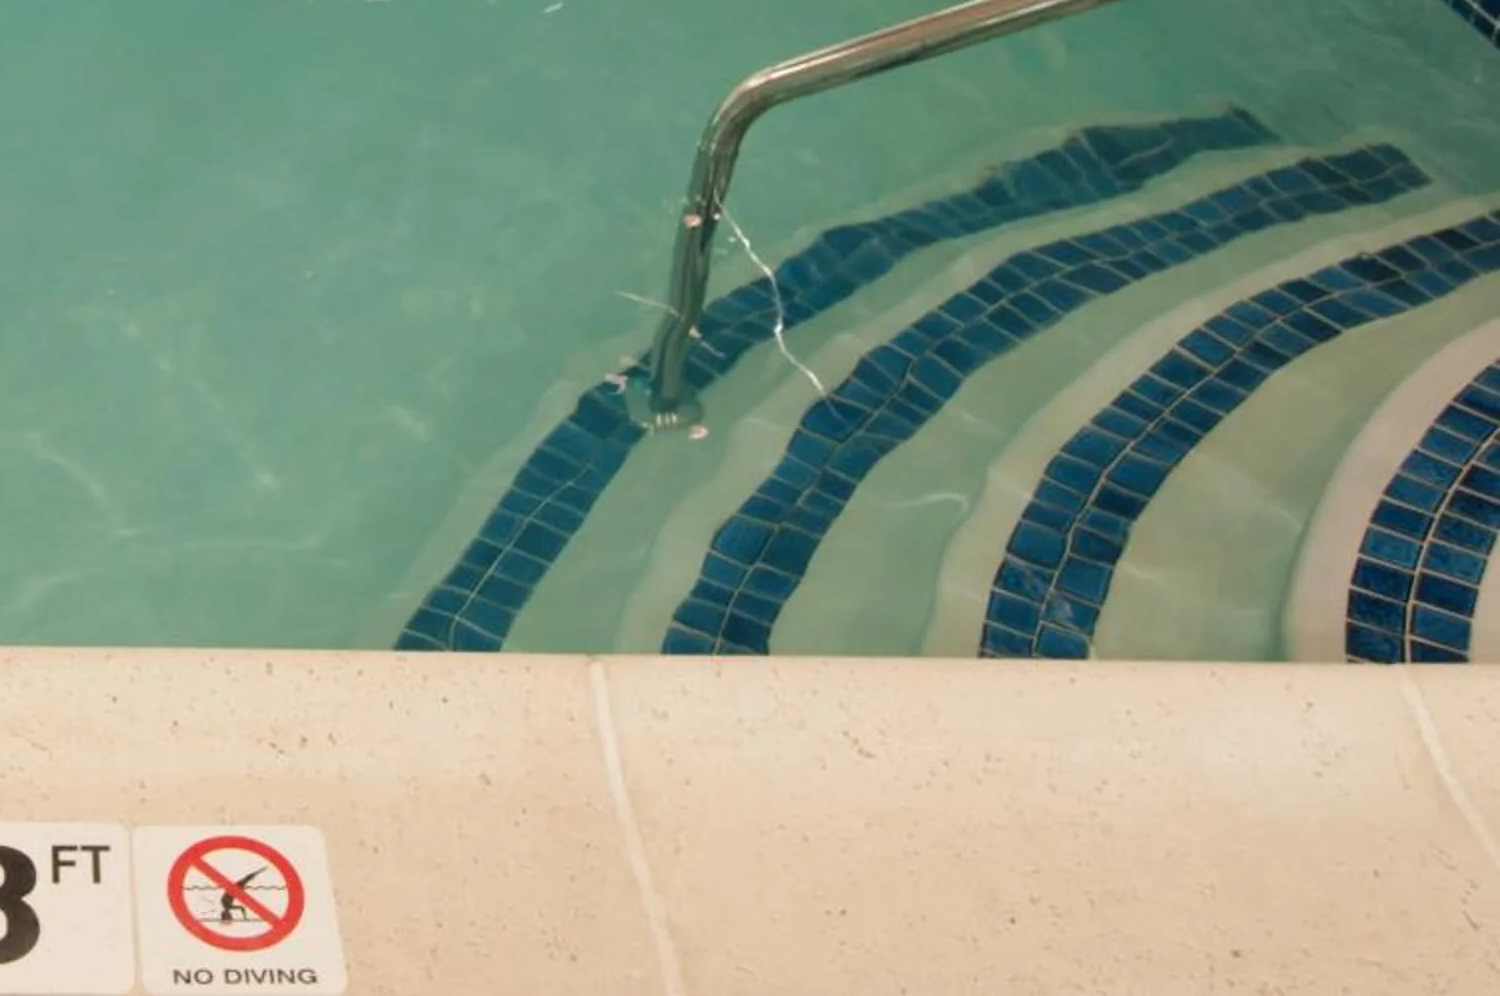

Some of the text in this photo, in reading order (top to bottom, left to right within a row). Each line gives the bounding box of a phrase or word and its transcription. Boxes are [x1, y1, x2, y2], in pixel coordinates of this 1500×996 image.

[51, 845, 111, 885] FT
[173, 968, 319, 986] NO DIVING
